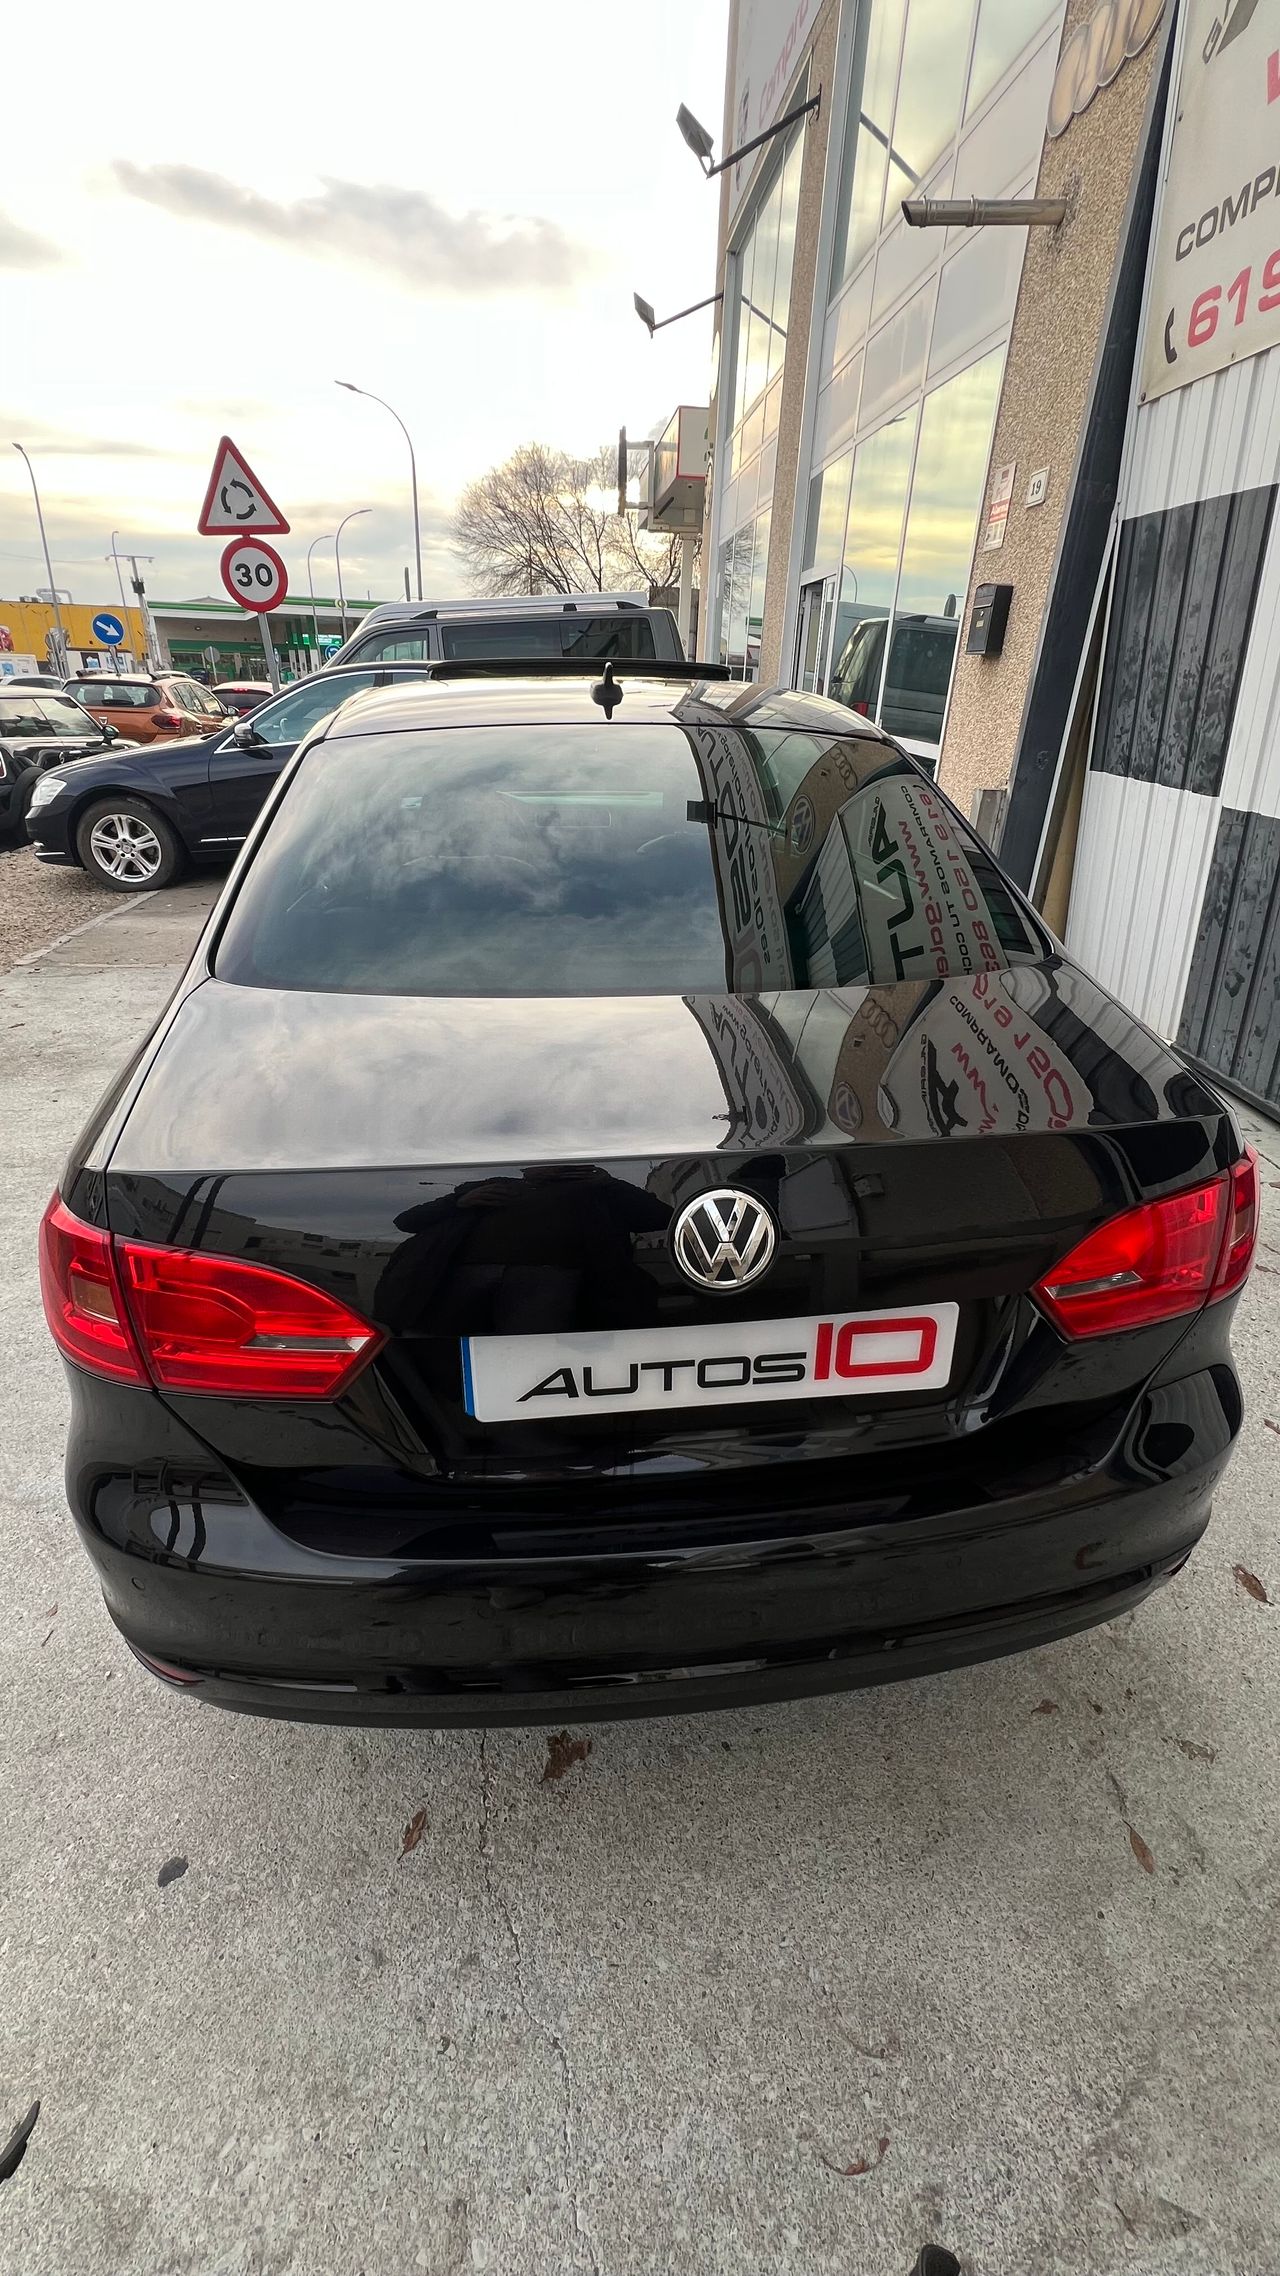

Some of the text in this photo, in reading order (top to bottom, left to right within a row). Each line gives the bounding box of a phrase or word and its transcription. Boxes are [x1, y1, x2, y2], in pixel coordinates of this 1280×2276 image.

[1175, 163, 1280, 262] COMP
[1187, 248, 1280, 348] 619
[1030, 479, 1042, 497] 19
[235, 563, 273, 587] 30
[516, 1316, 937, 1402] AUTOS10
